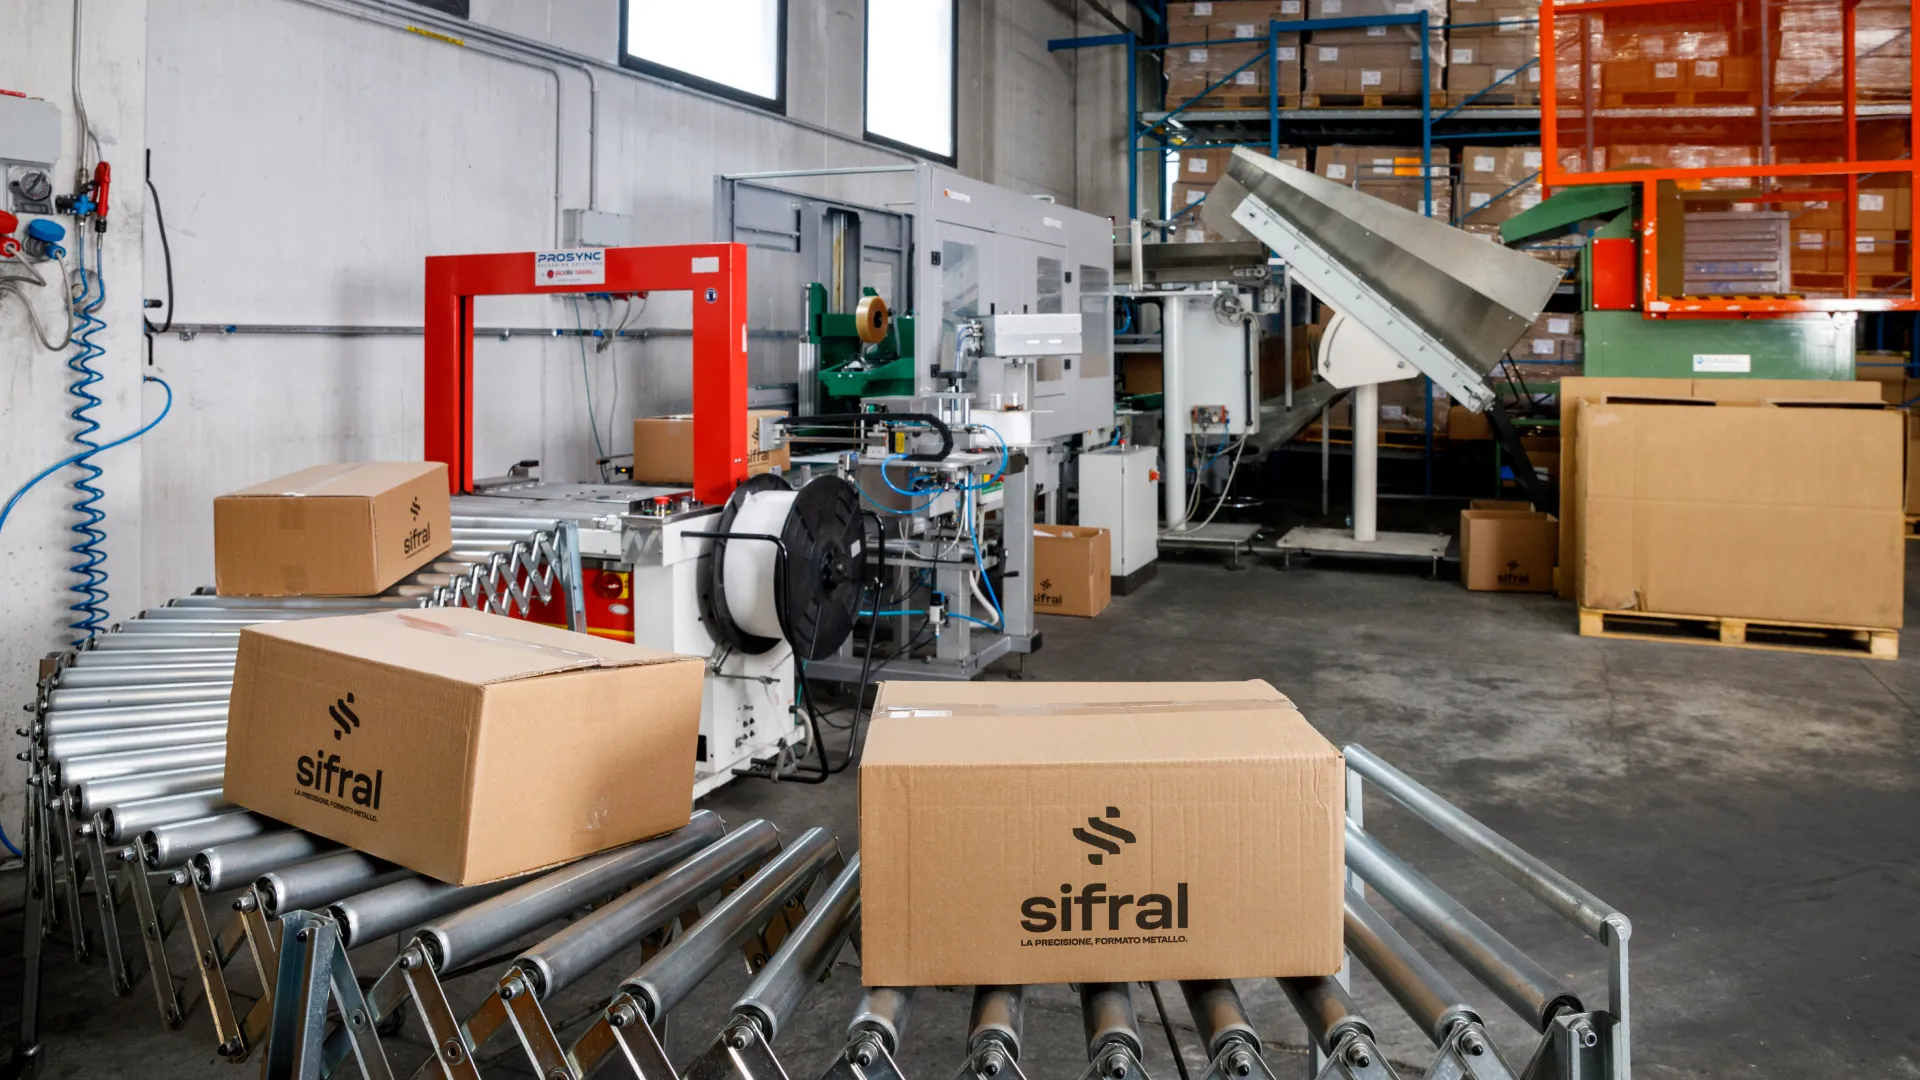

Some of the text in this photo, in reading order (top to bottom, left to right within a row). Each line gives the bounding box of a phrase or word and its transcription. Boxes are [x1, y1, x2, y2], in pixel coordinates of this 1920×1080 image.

[538, 252, 601, 262] PROSYNC
[404, 521, 431, 554] sifral
[296, 749, 383, 810] sifral
[294, 788, 300, 796] LA
[301, 791, 330, 807] PRECISIONE,
[330, 800, 354, 815] FORMATO
[1020, 882, 1188, 933] sifral
[1020, 935, 1188, 947] LA PRECISIONE, FORMATO METALLO.
